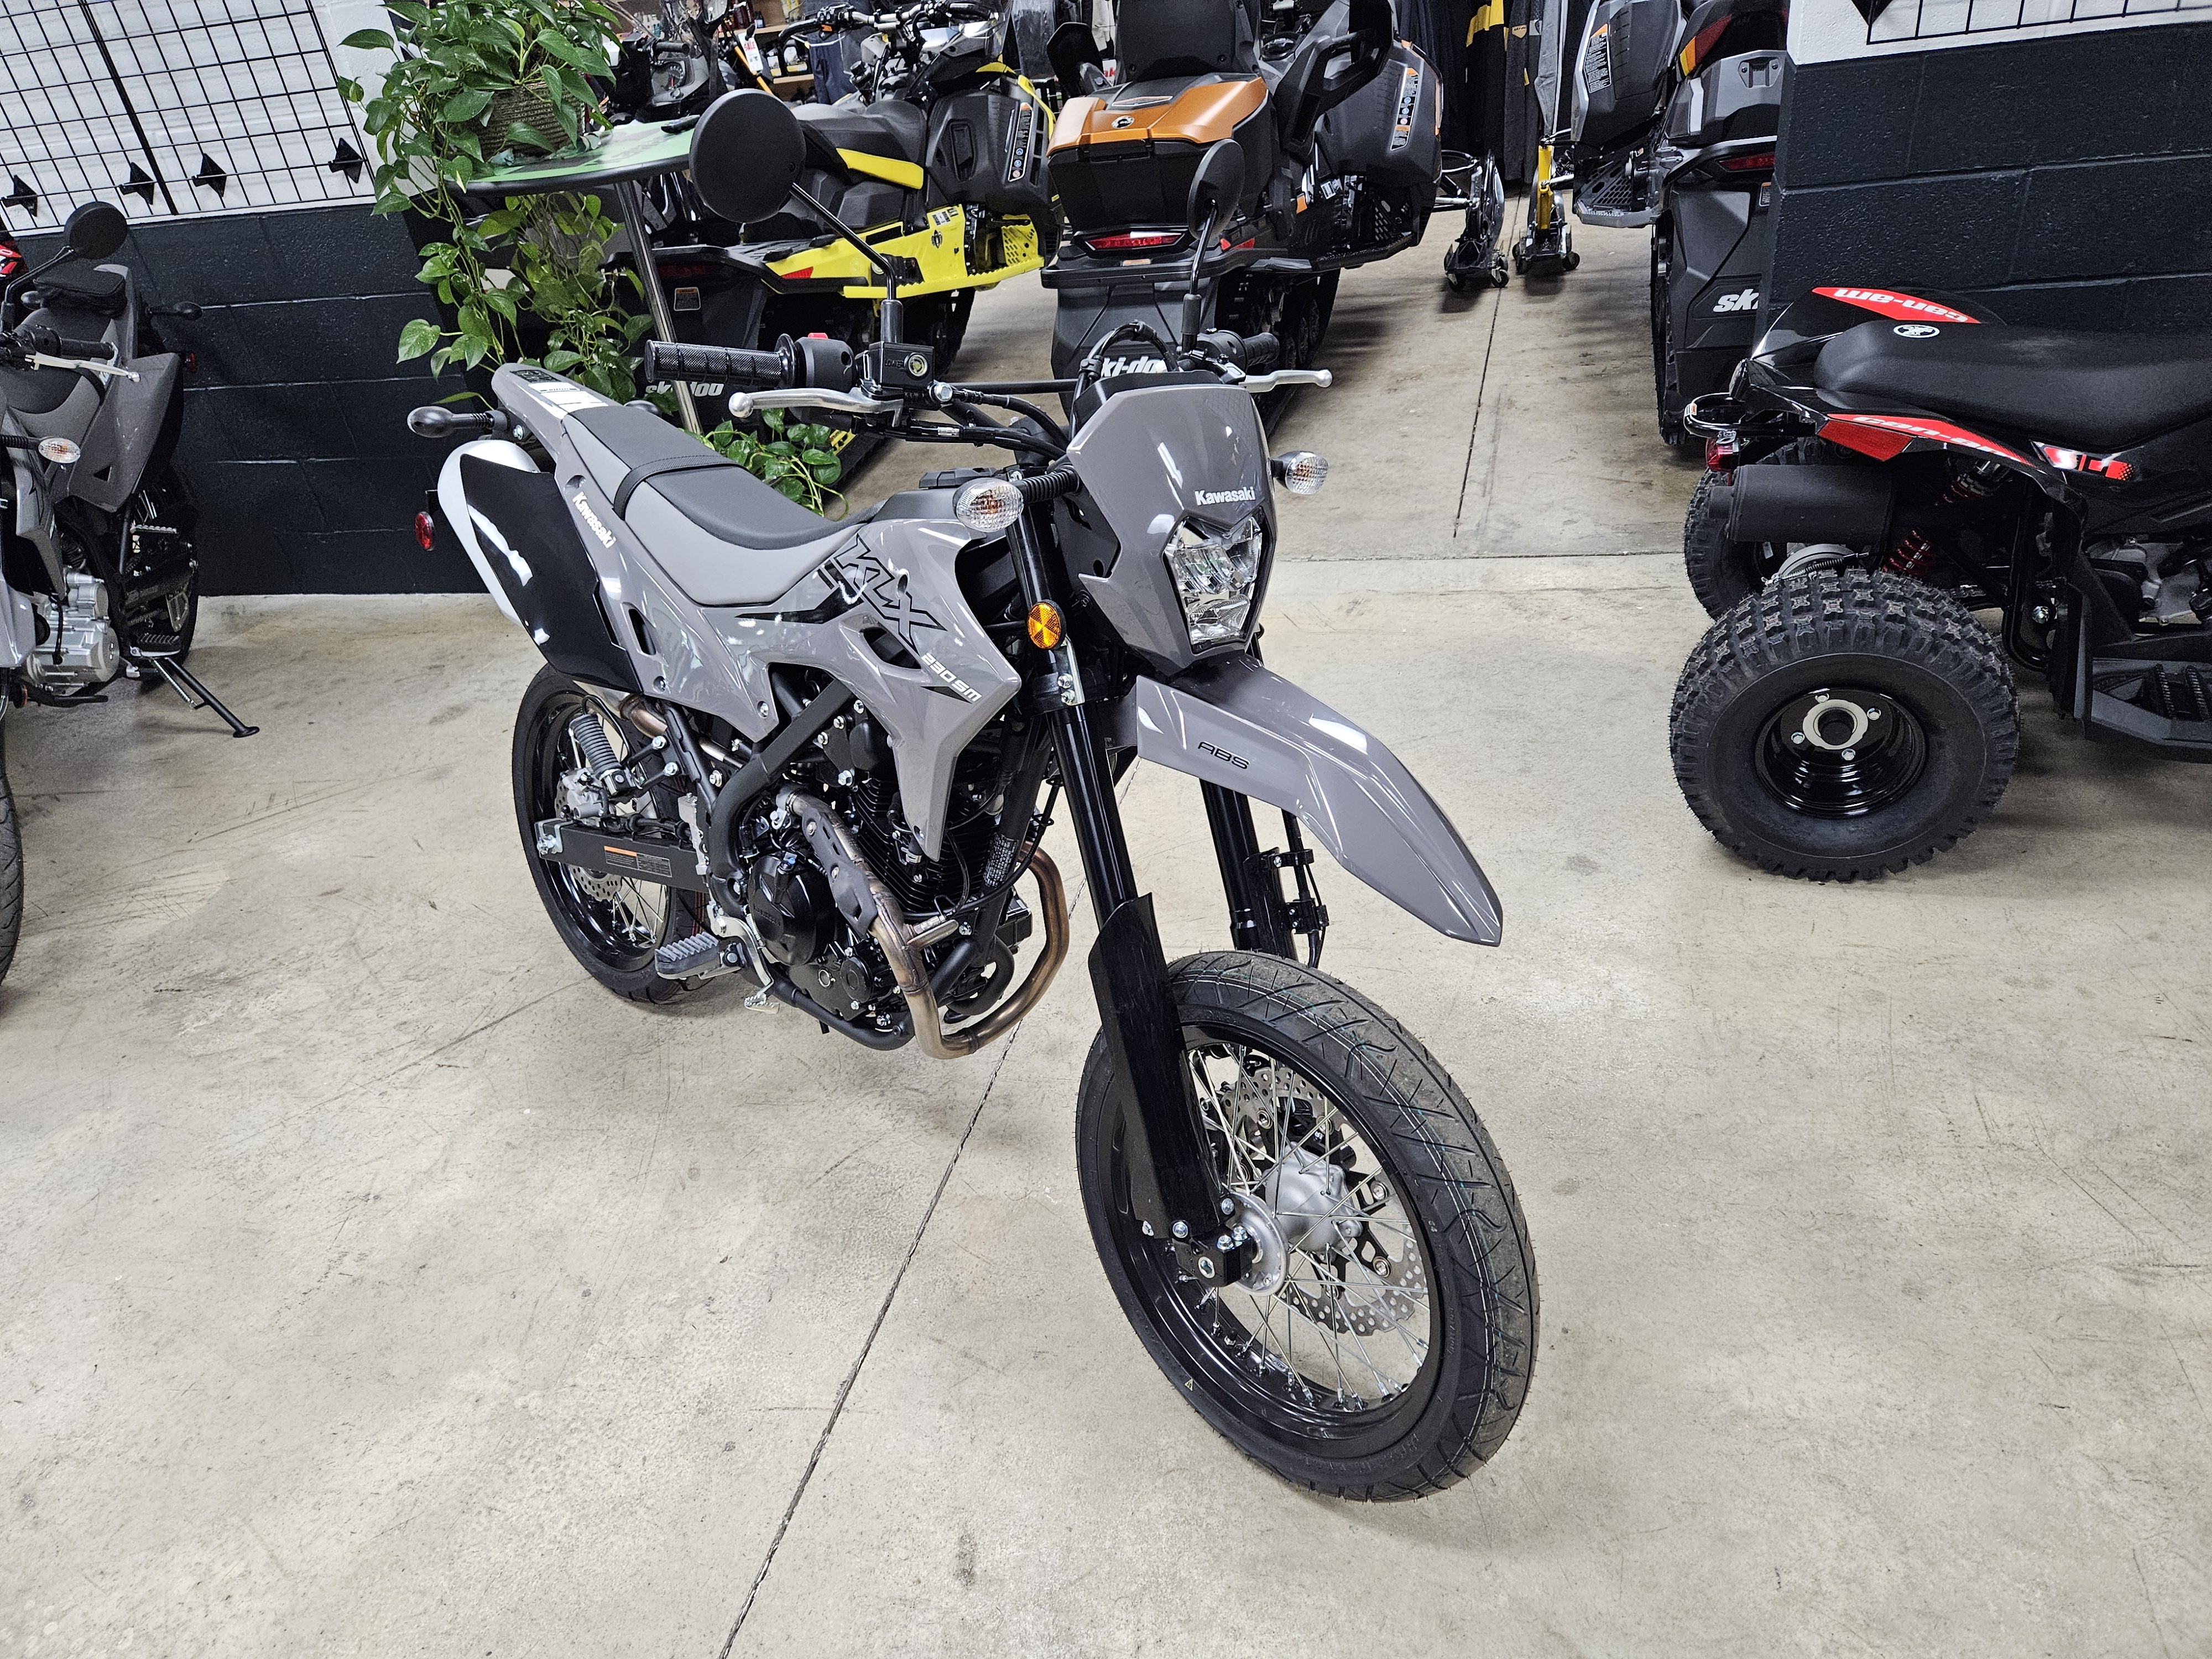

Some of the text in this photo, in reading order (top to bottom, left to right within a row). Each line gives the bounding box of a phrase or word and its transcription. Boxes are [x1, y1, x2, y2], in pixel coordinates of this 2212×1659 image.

[1834, 289, 1968, 322] can-am
[1100, 356, 1161, 377] ki-do
[1194, 486, 1256, 506] Kawasaki
[572, 491, 617, 549] Kawasaki
[833, 533, 948, 657] KLX
[1197, 742, 1249, 769] ABS
